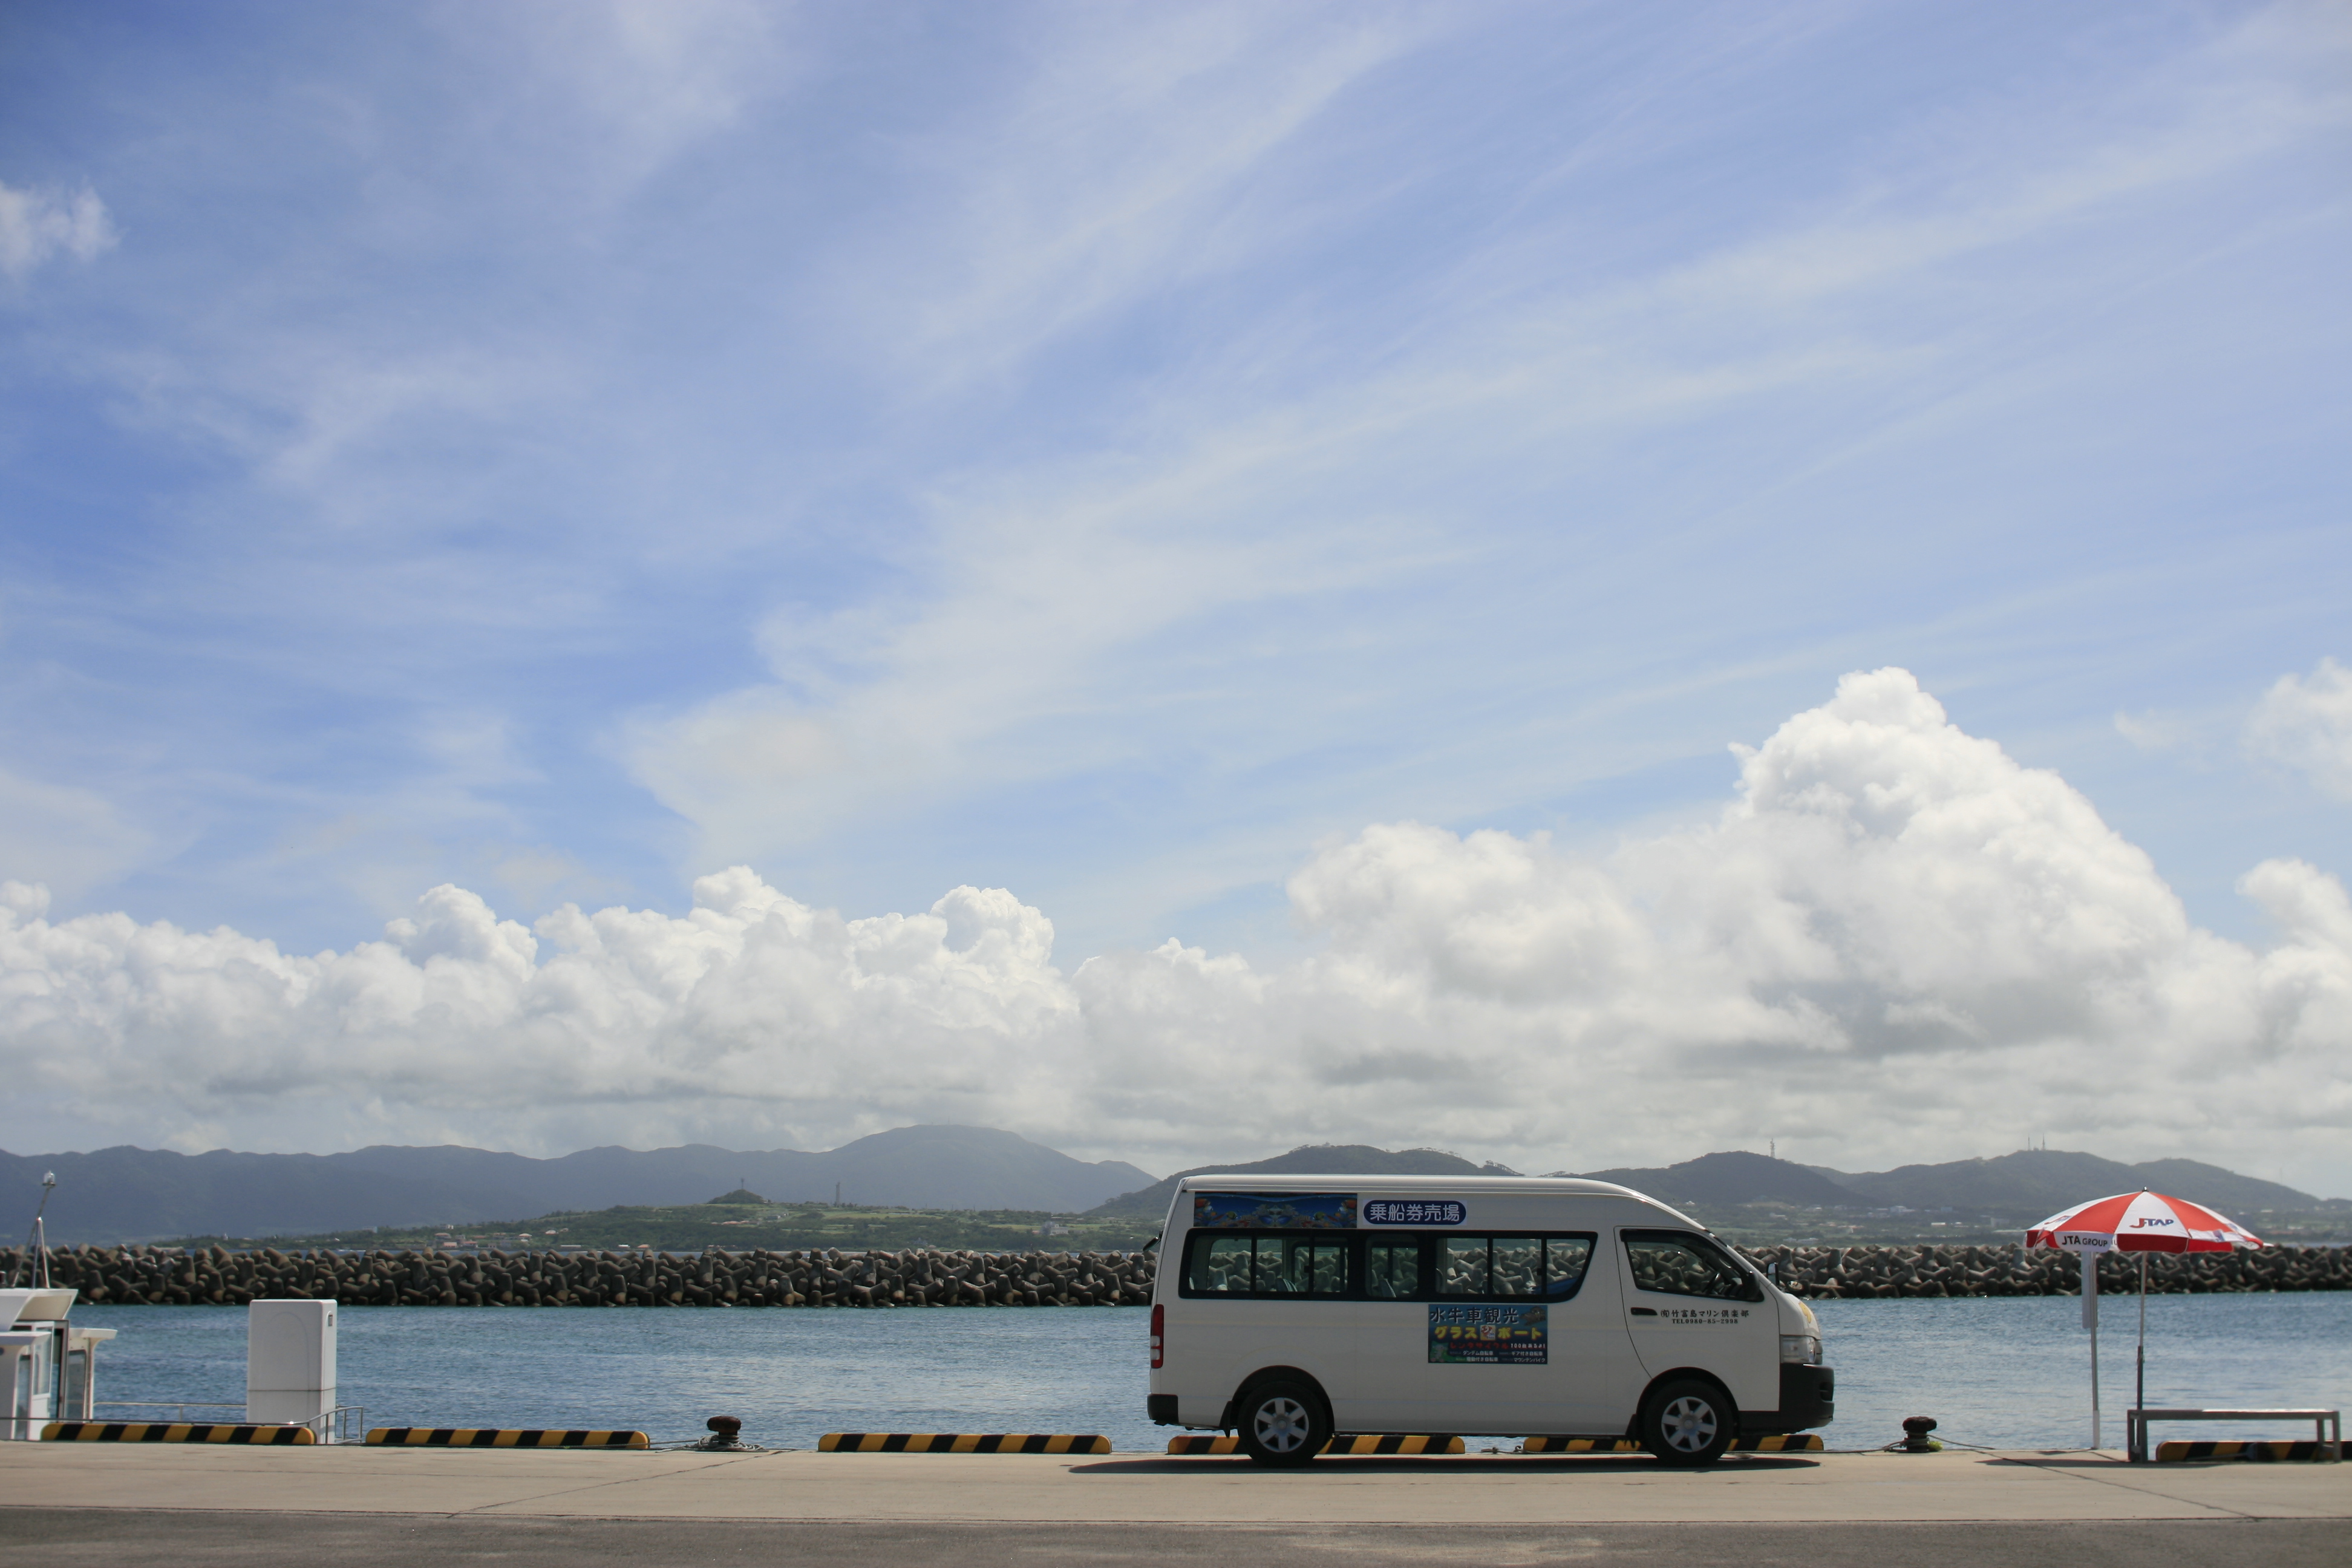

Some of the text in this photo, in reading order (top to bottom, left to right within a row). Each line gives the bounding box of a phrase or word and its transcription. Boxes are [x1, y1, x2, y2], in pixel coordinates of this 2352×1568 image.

[1370, 1204, 1460, 1221] 乗船券売場
[2062, 1235, 2080, 1245] JTA
[2082, 1238, 2108, 1247] GROUP
[1430, 1307, 1520, 1324] 水牛車観光
[1434, 1325, 1542, 1340] グラス ボート
